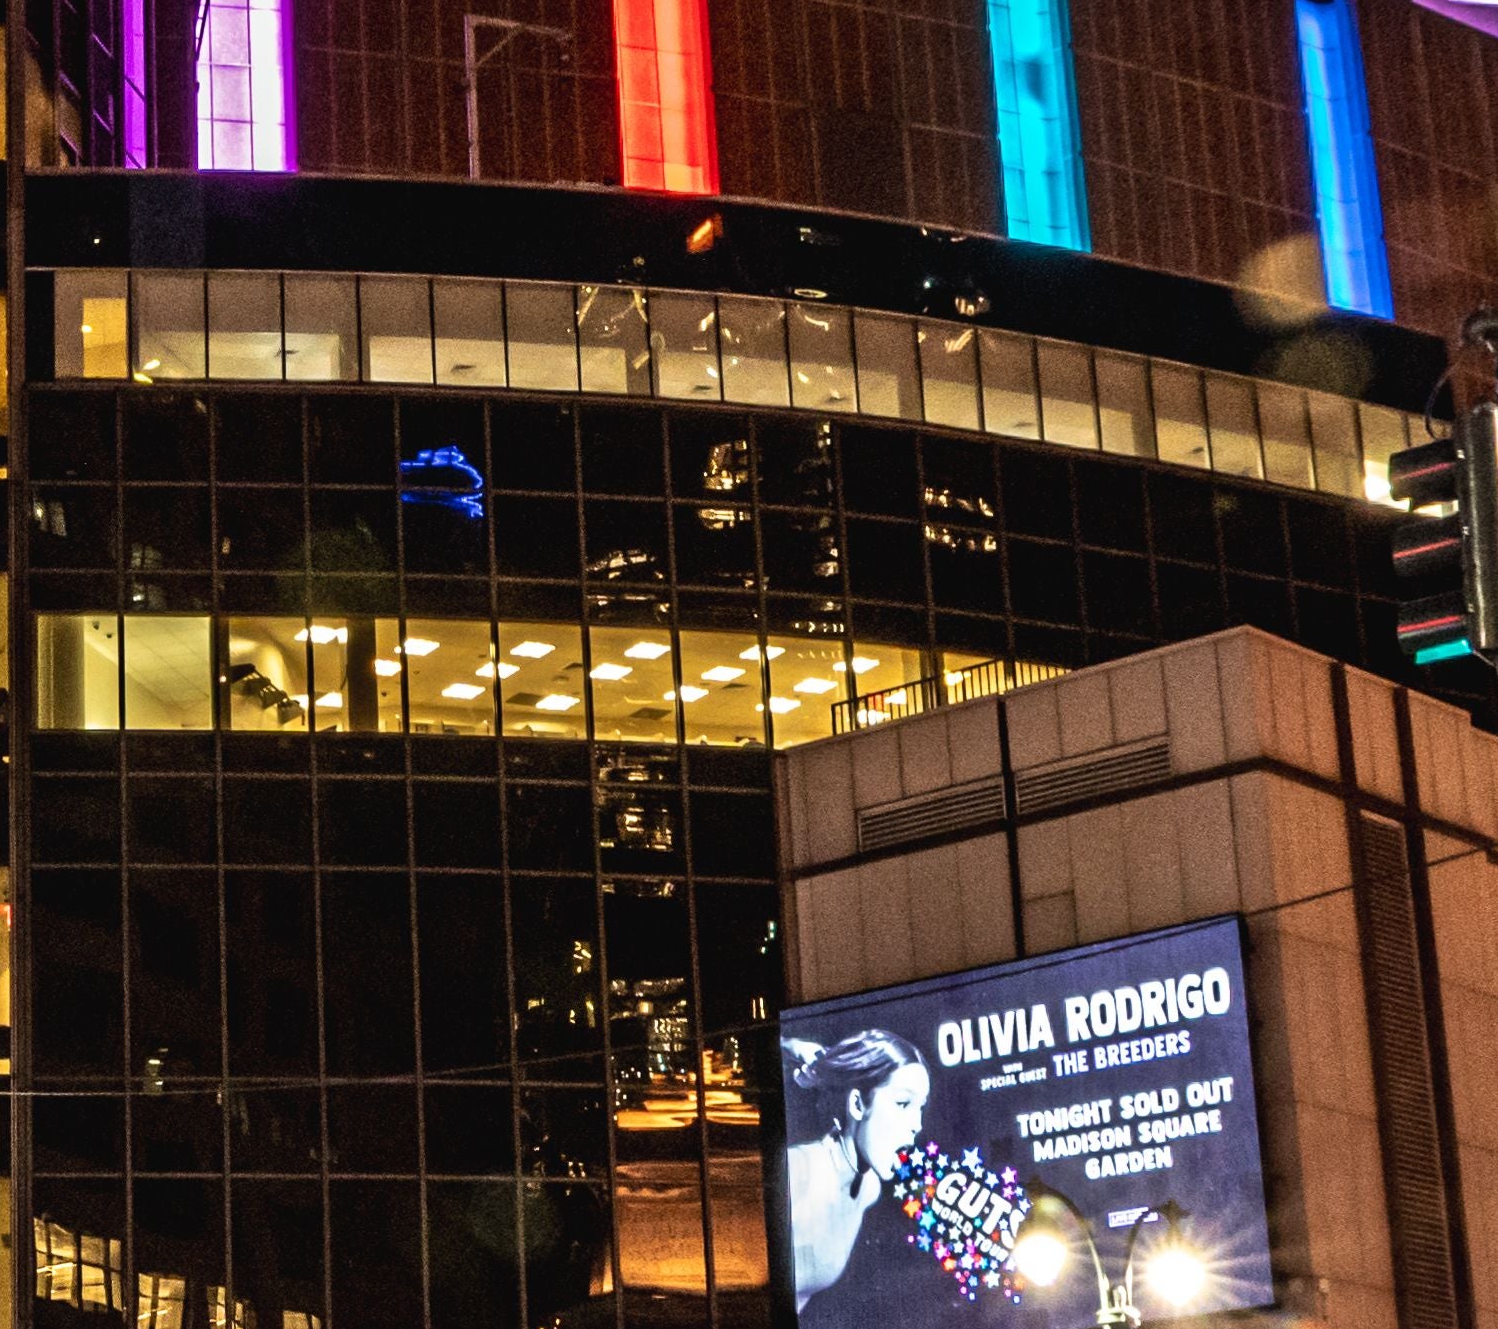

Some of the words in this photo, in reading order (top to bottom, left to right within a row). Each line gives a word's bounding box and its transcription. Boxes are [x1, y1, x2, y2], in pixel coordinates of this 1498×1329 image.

[937, 1003, 1055, 1067] OLIVIA
[1065, 967, 1231, 1043] RODRIGO
[1053, 1047, 1089, 1077] THE
[1094, 1030, 1191, 1071] BREEDERS
[1016, 1098, 1113, 1138] TONIGHT
[1121, 1086, 1180, 1121] SOLD
[1187, 1077, 1234, 1108] OUT
[1032, 1127, 1132, 1162] MADISON
[1138, 1109, 1223, 1145] SQUARE
[1085, 1146, 1173, 1180] GARDEN
[930, 1199, 973, 1237] WORLD
[974, 1231, 1010, 1263] TOUR
